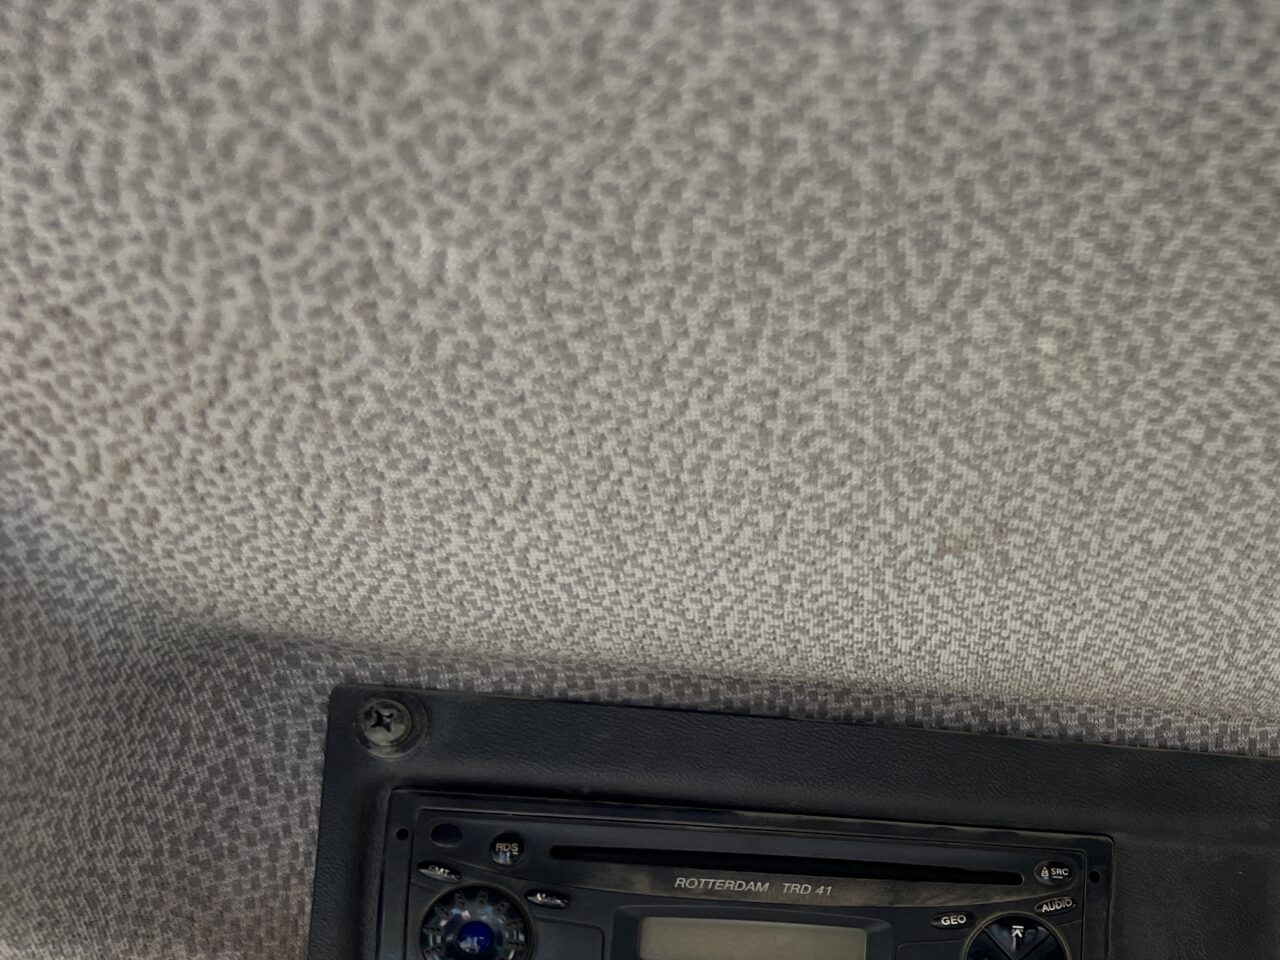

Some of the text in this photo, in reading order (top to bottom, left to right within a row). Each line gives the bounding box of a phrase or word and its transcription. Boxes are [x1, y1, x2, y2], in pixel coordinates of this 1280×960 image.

[495, 842, 519, 853] RDS
[1050, 867, 1070, 876] SRC
[674, 876, 833, 897] ROTTERDAM TRD 41
[1041, 897, 1074, 913] AUDIO
[940, 914, 968, 926] GEO
